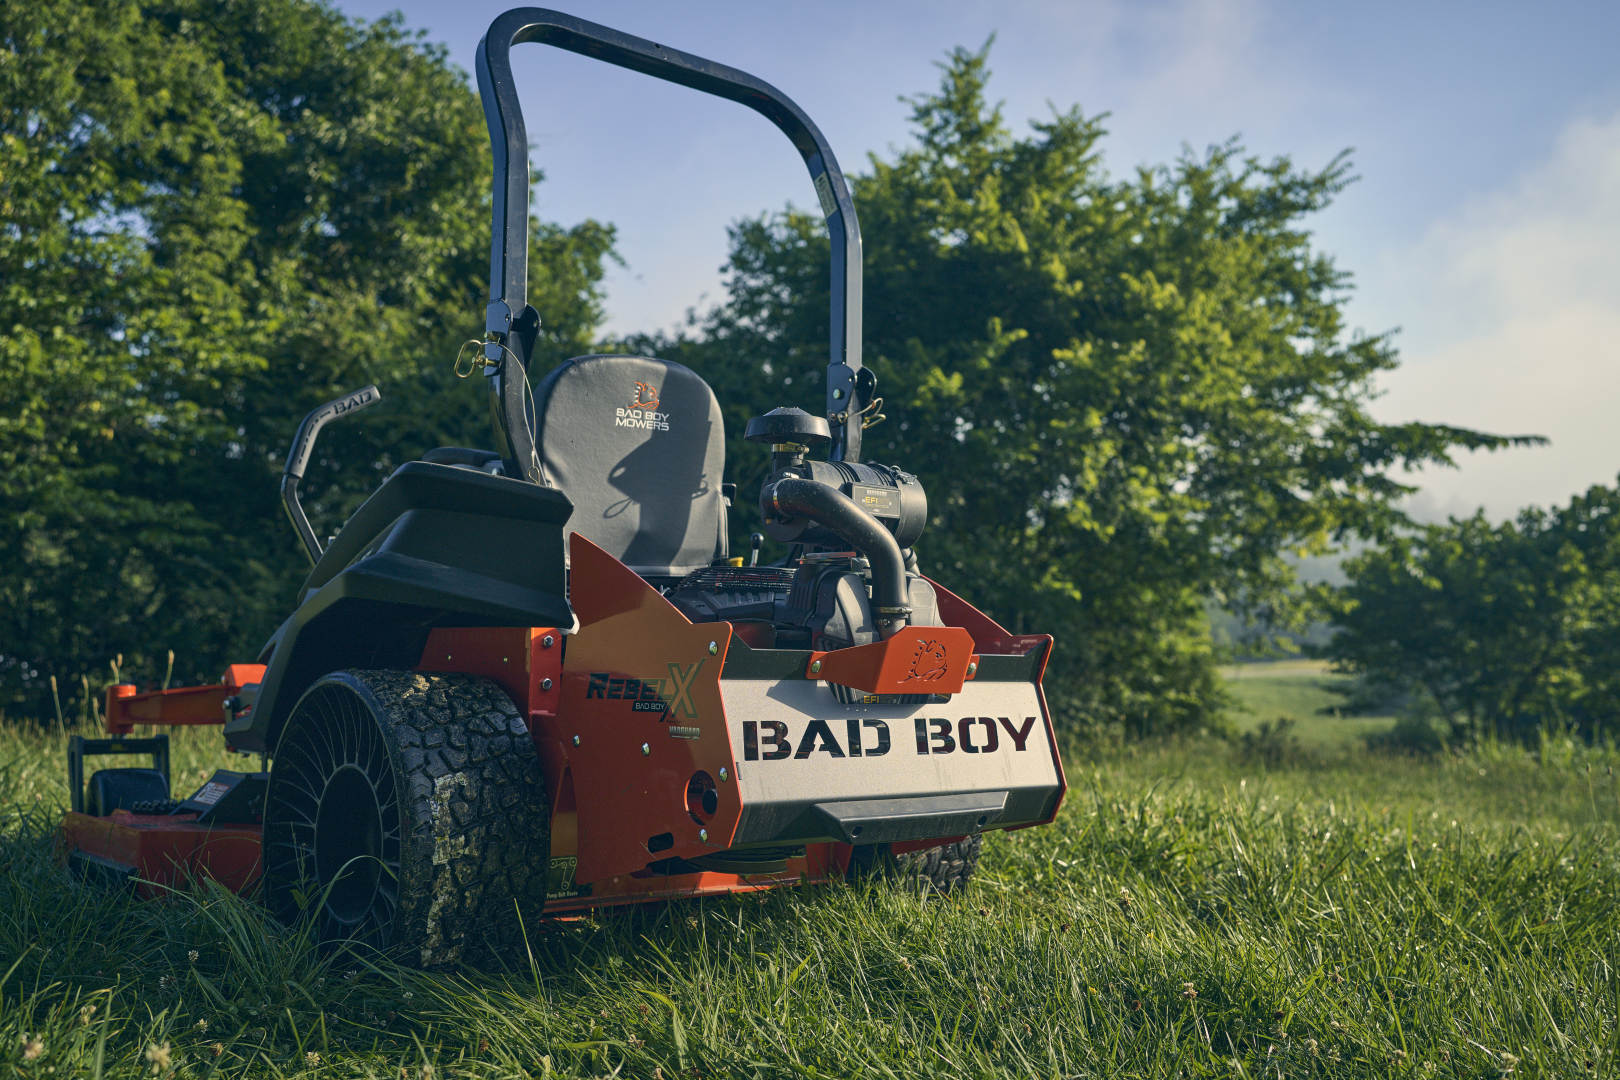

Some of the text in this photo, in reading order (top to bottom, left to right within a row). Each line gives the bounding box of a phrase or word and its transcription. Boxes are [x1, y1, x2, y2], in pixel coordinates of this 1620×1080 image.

[333, 391, 372, 415] BAD
[616, 408, 670, 422] BAD BOY
[615, 417, 670, 431] MOWERS
[865, 496, 878, 504] EFI
[635, 702, 665, 710] BAD BOY
[742, 716, 1037, 761] BAD BOY
